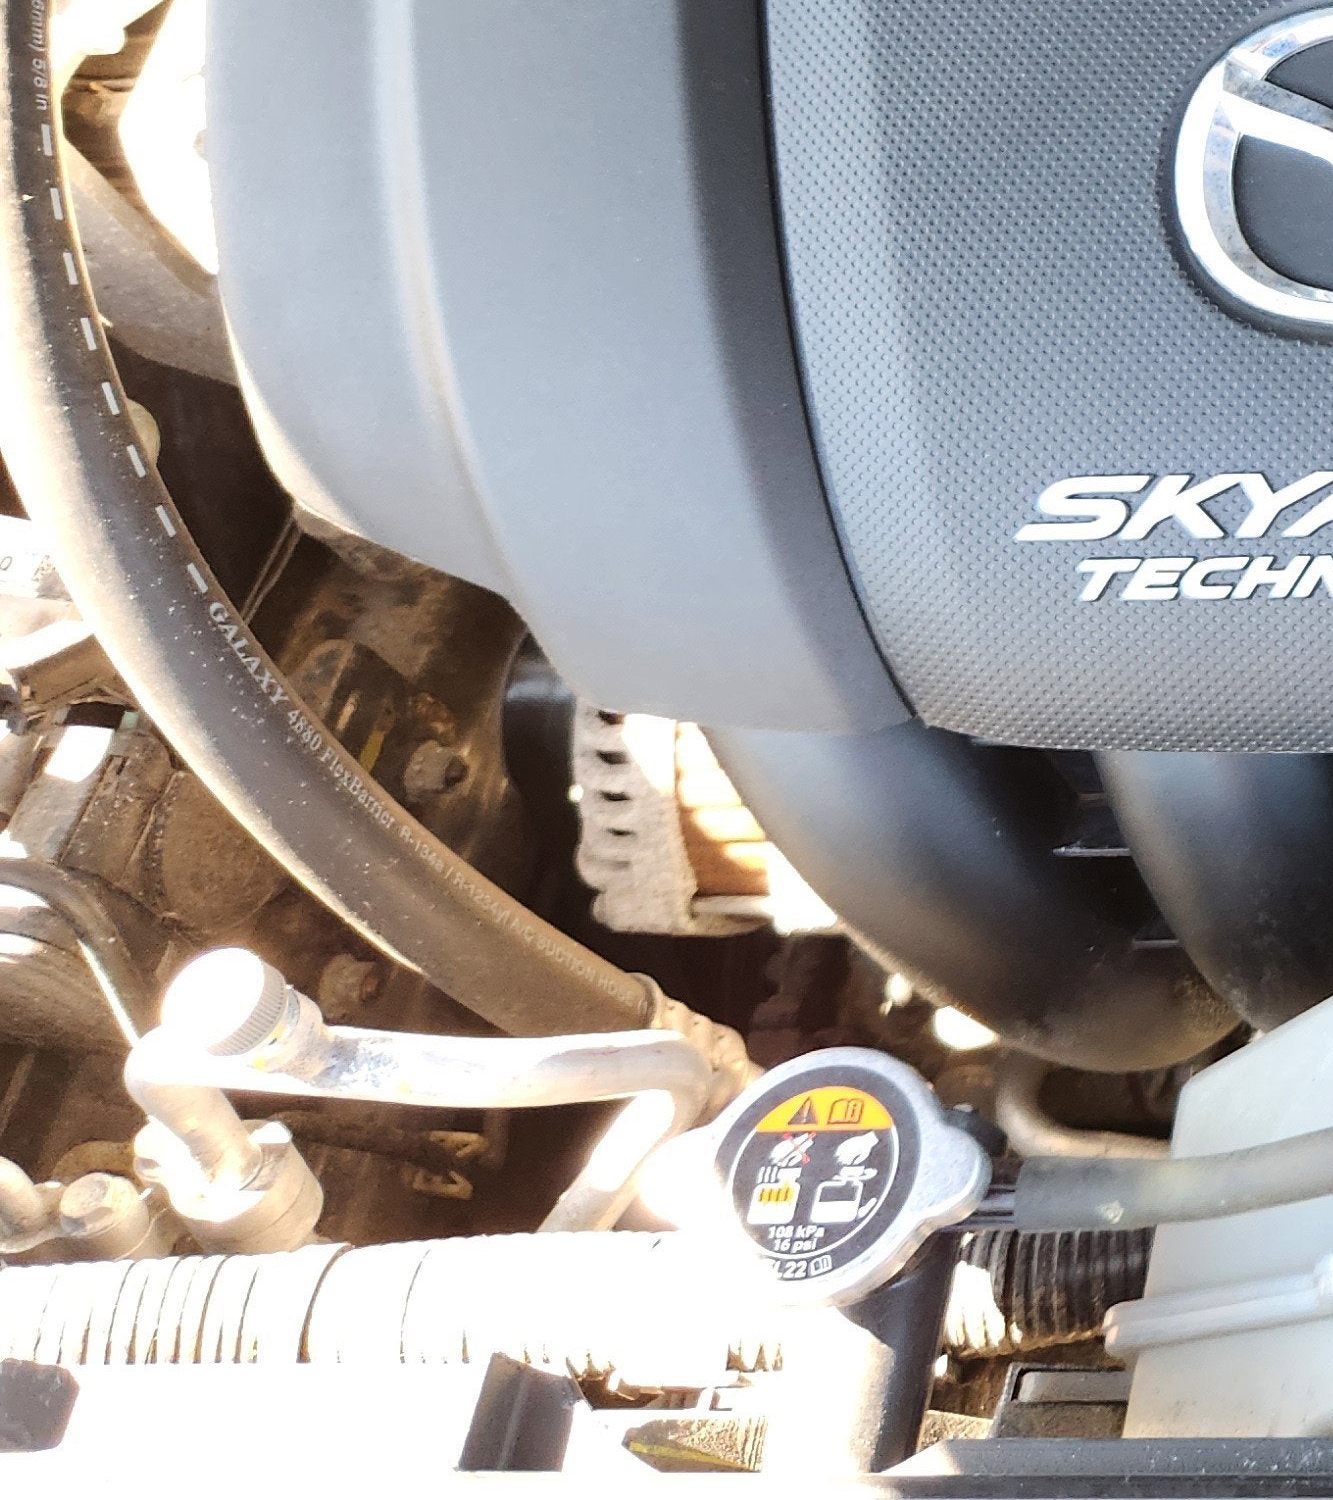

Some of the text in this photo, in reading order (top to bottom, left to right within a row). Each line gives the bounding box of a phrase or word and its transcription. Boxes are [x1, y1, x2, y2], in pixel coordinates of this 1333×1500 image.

[210, 602, 290, 704] GALAXY
[287, 709, 323, 751] 4880
[768, 1225, 825, 1239] 108 kPa
[774, 1238, 818, 1253] 16 psi
